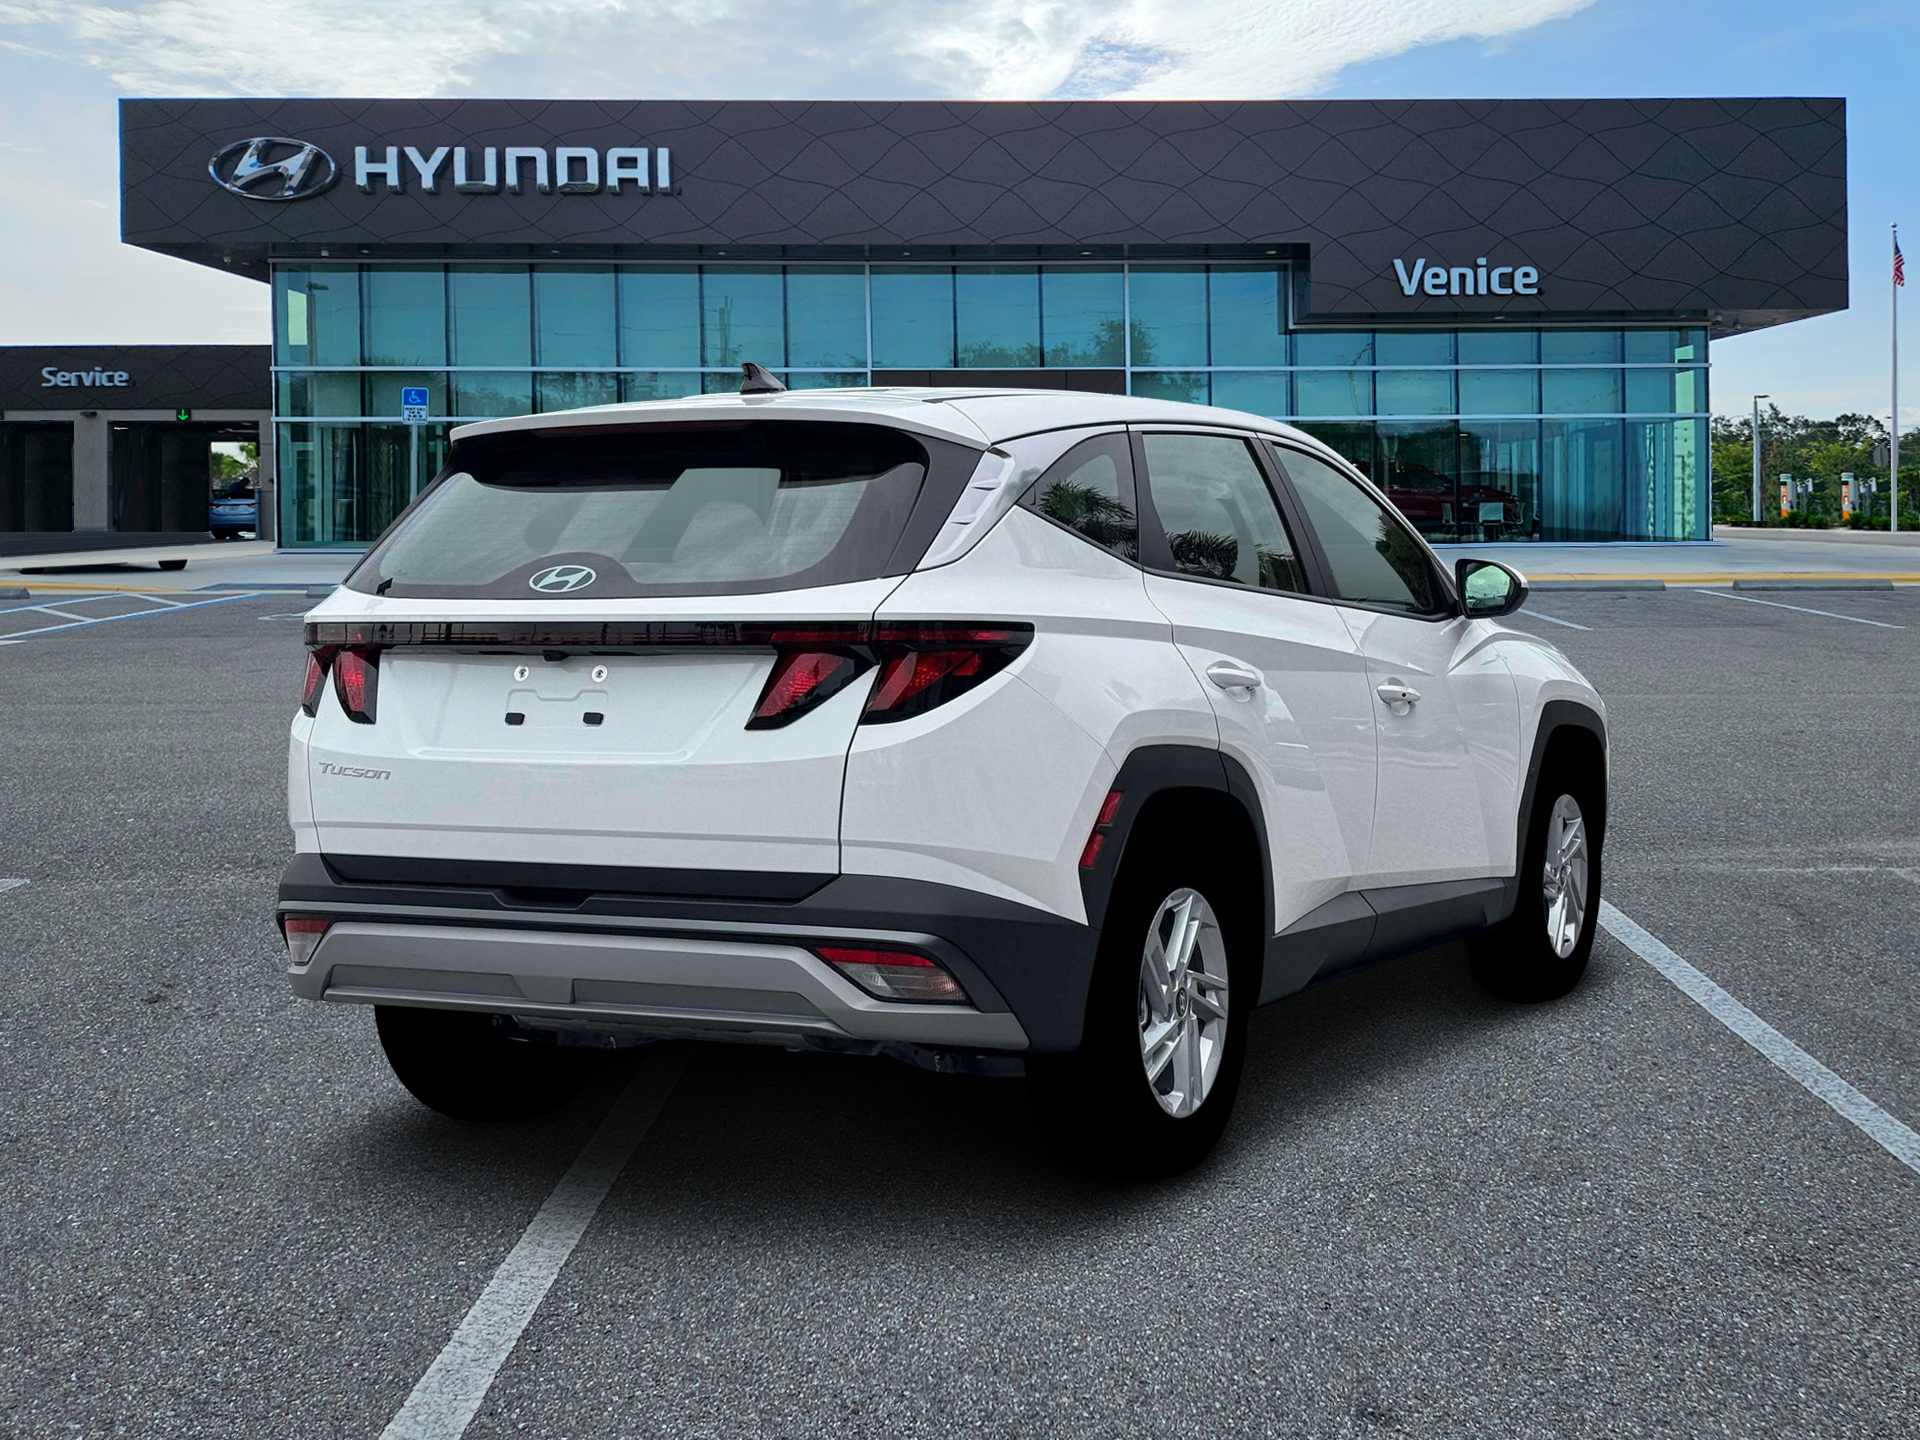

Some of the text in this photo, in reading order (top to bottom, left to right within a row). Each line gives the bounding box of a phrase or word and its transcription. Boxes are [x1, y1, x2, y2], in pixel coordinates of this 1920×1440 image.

[355, 146, 672, 193] HYUNDAI
[1393, 257, 1538, 296] Venice
[41, 366, 130, 387] Service
